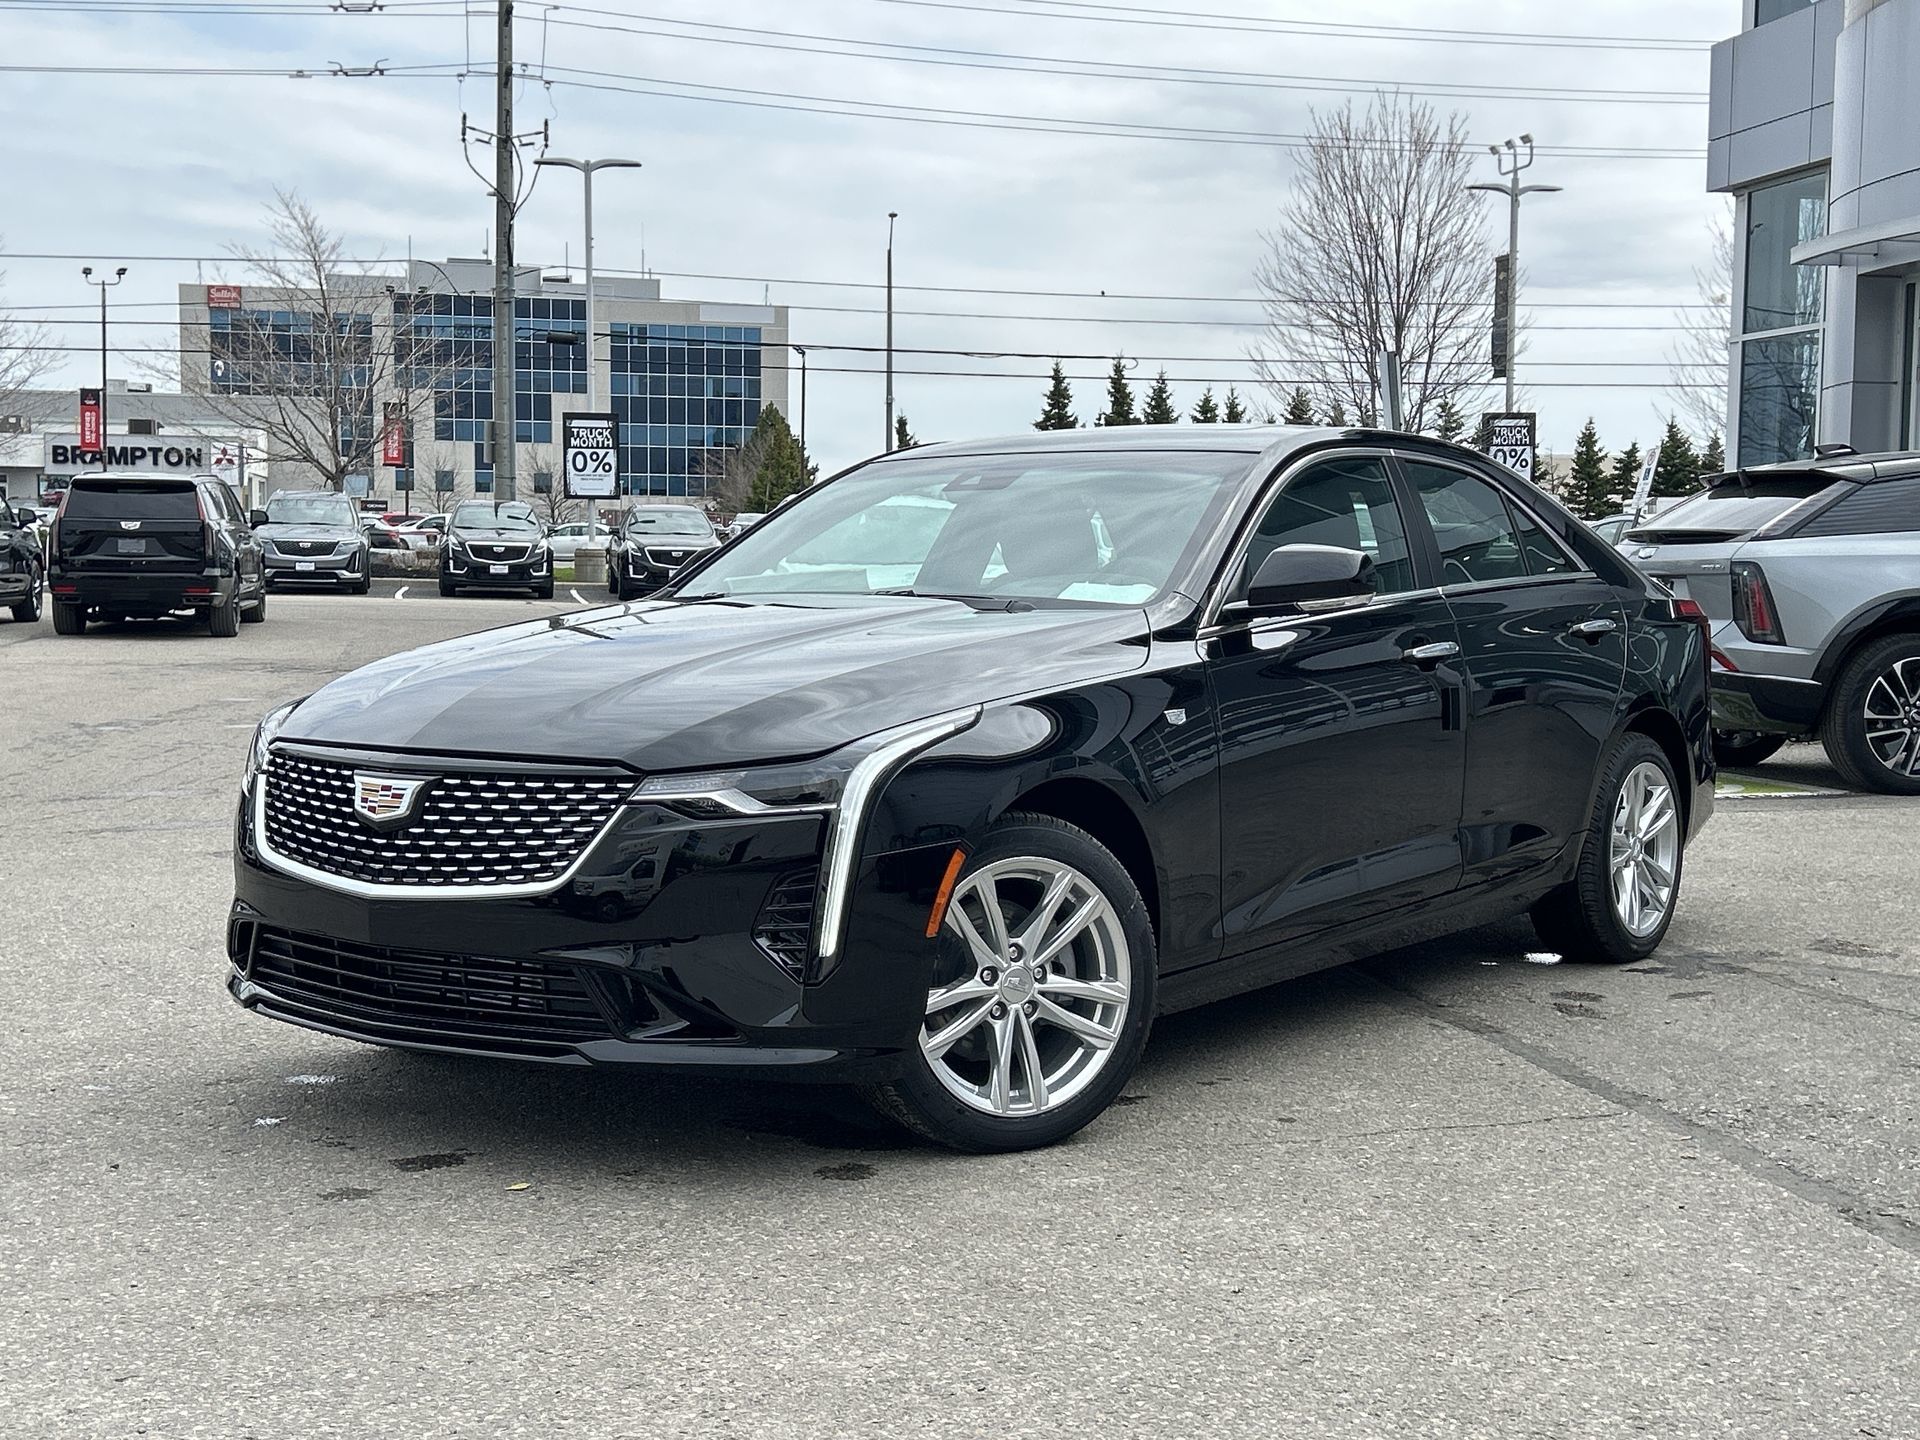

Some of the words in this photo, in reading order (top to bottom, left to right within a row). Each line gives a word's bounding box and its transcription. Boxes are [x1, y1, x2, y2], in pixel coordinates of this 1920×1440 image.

[571, 428, 611, 439] TRUCK
[1494, 427, 1529, 437] TRUCK
[570, 437, 613, 448] MONTH
[1492, 436, 1530, 445] MONTH
[51, 445, 202, 467] BRAMPTON
[571, 450, 613, 473] 0%
